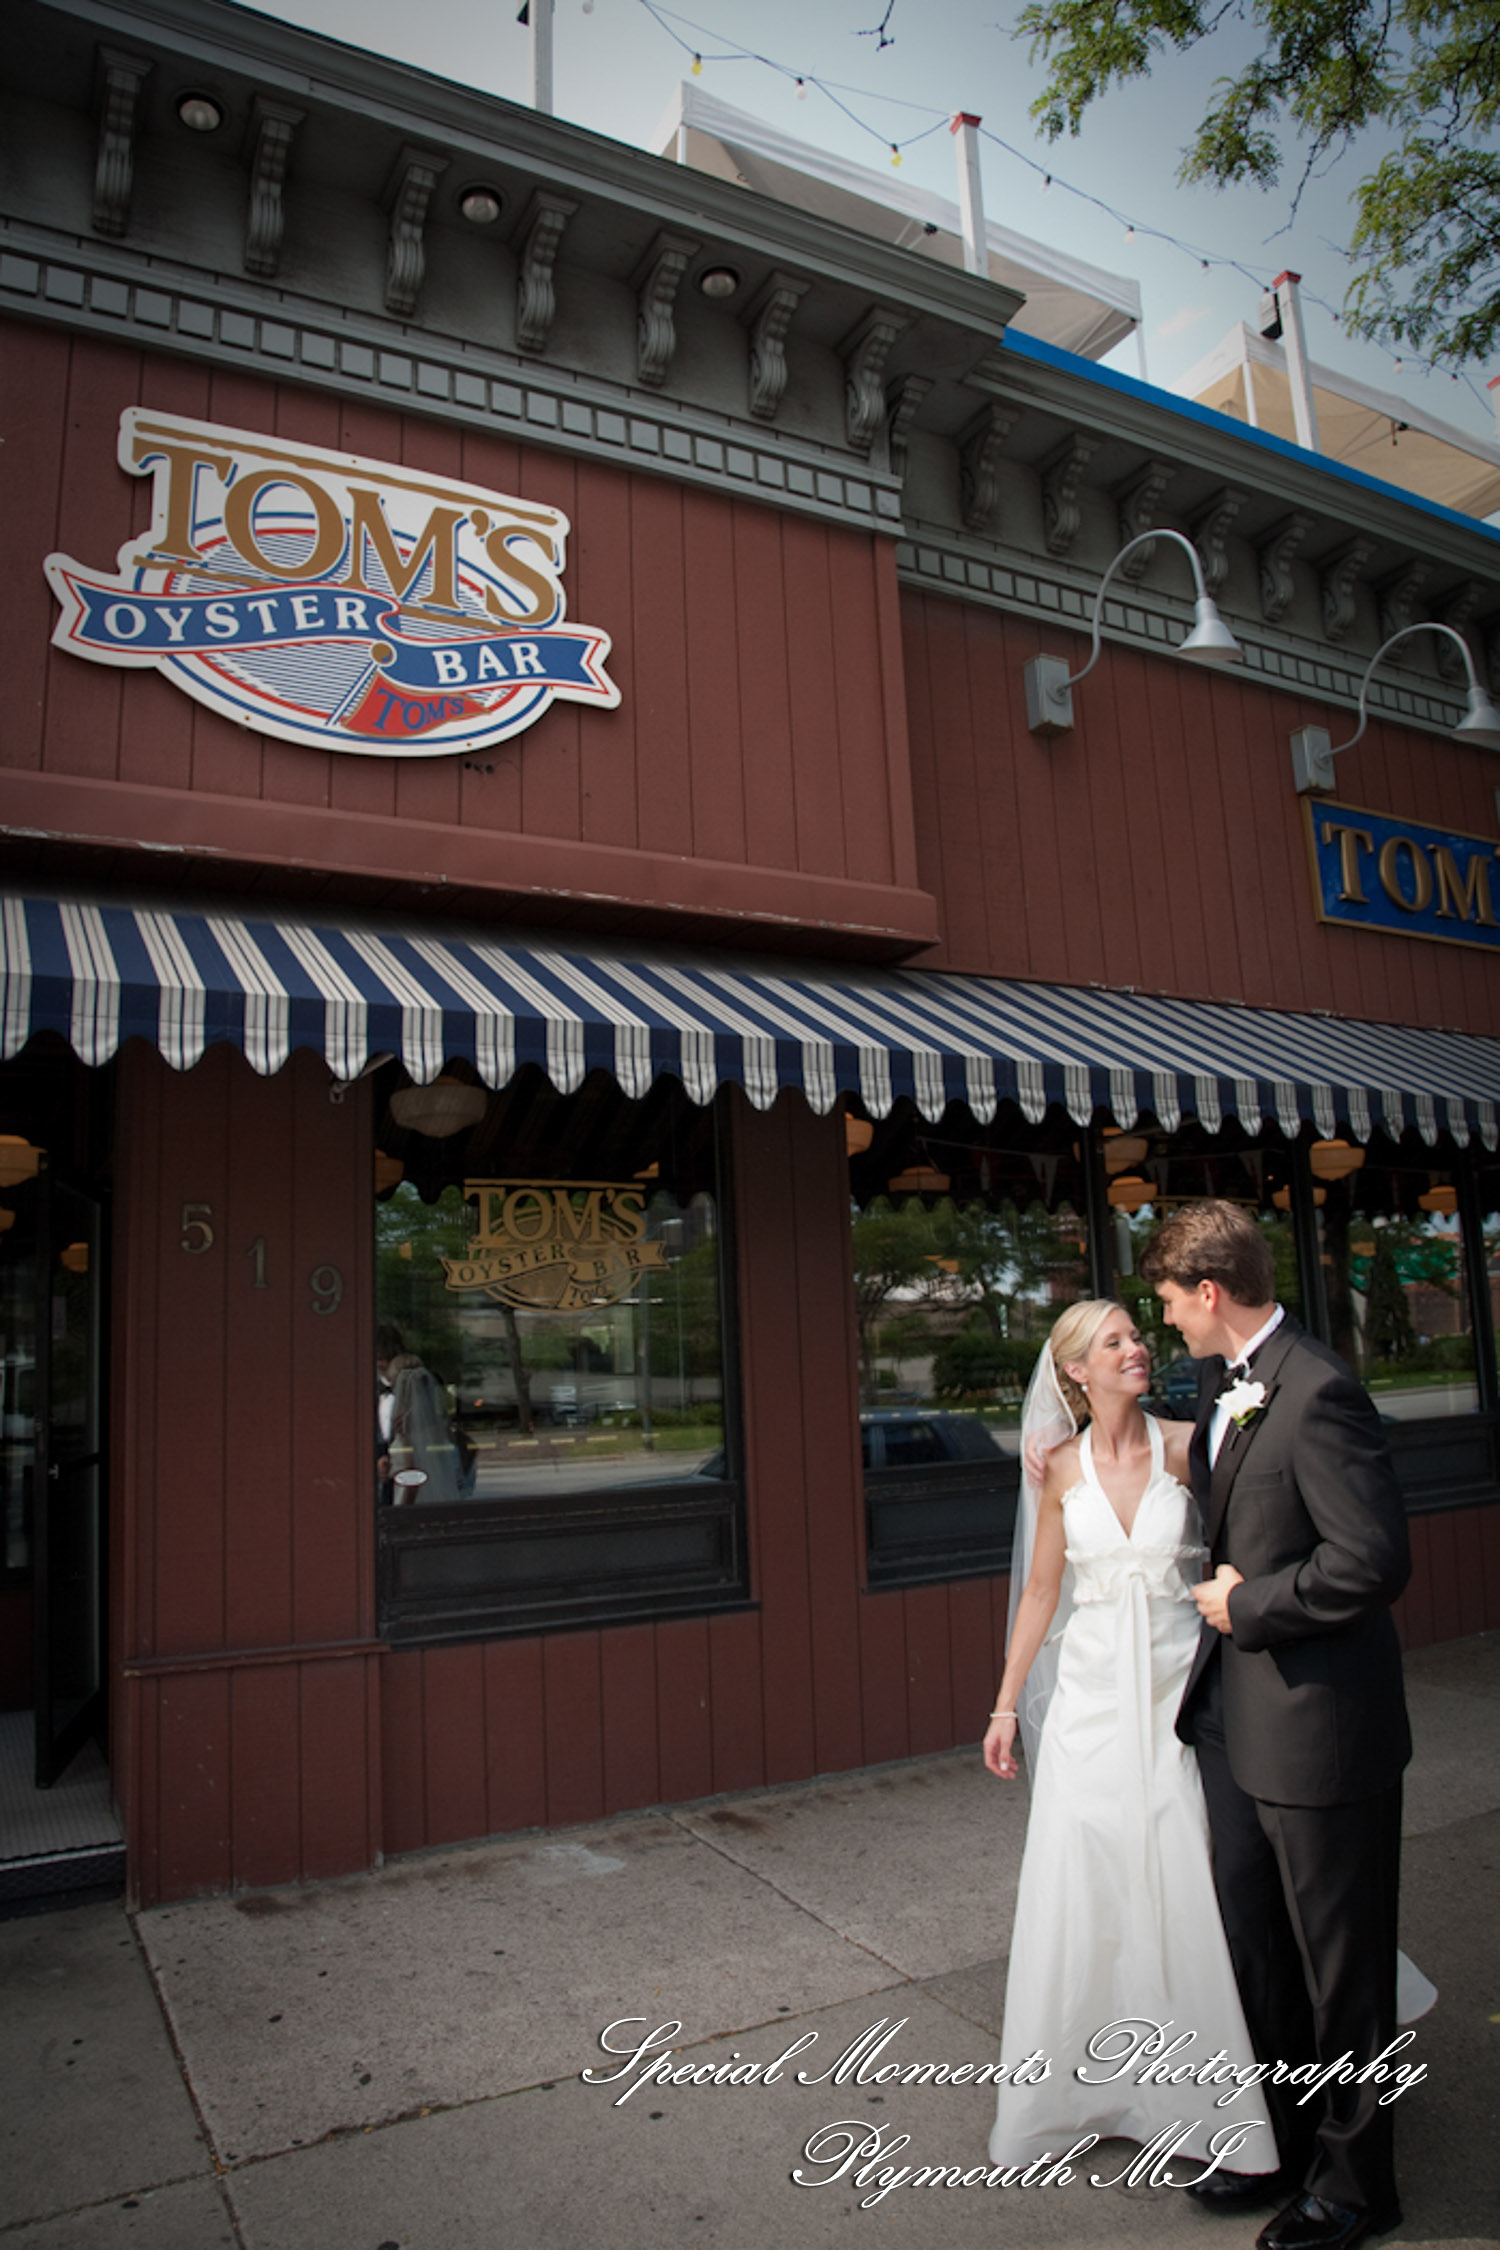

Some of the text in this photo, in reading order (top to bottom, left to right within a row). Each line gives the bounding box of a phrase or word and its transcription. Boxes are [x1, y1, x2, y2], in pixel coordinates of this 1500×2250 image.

[132, 436, 560, 625] TOM'S
[104, 595, 546, 684] OYSTER BAR
[464, 1187, 646, 1242] TOM'S
[458, 1244, 641, 1283] OYSTER BAR
